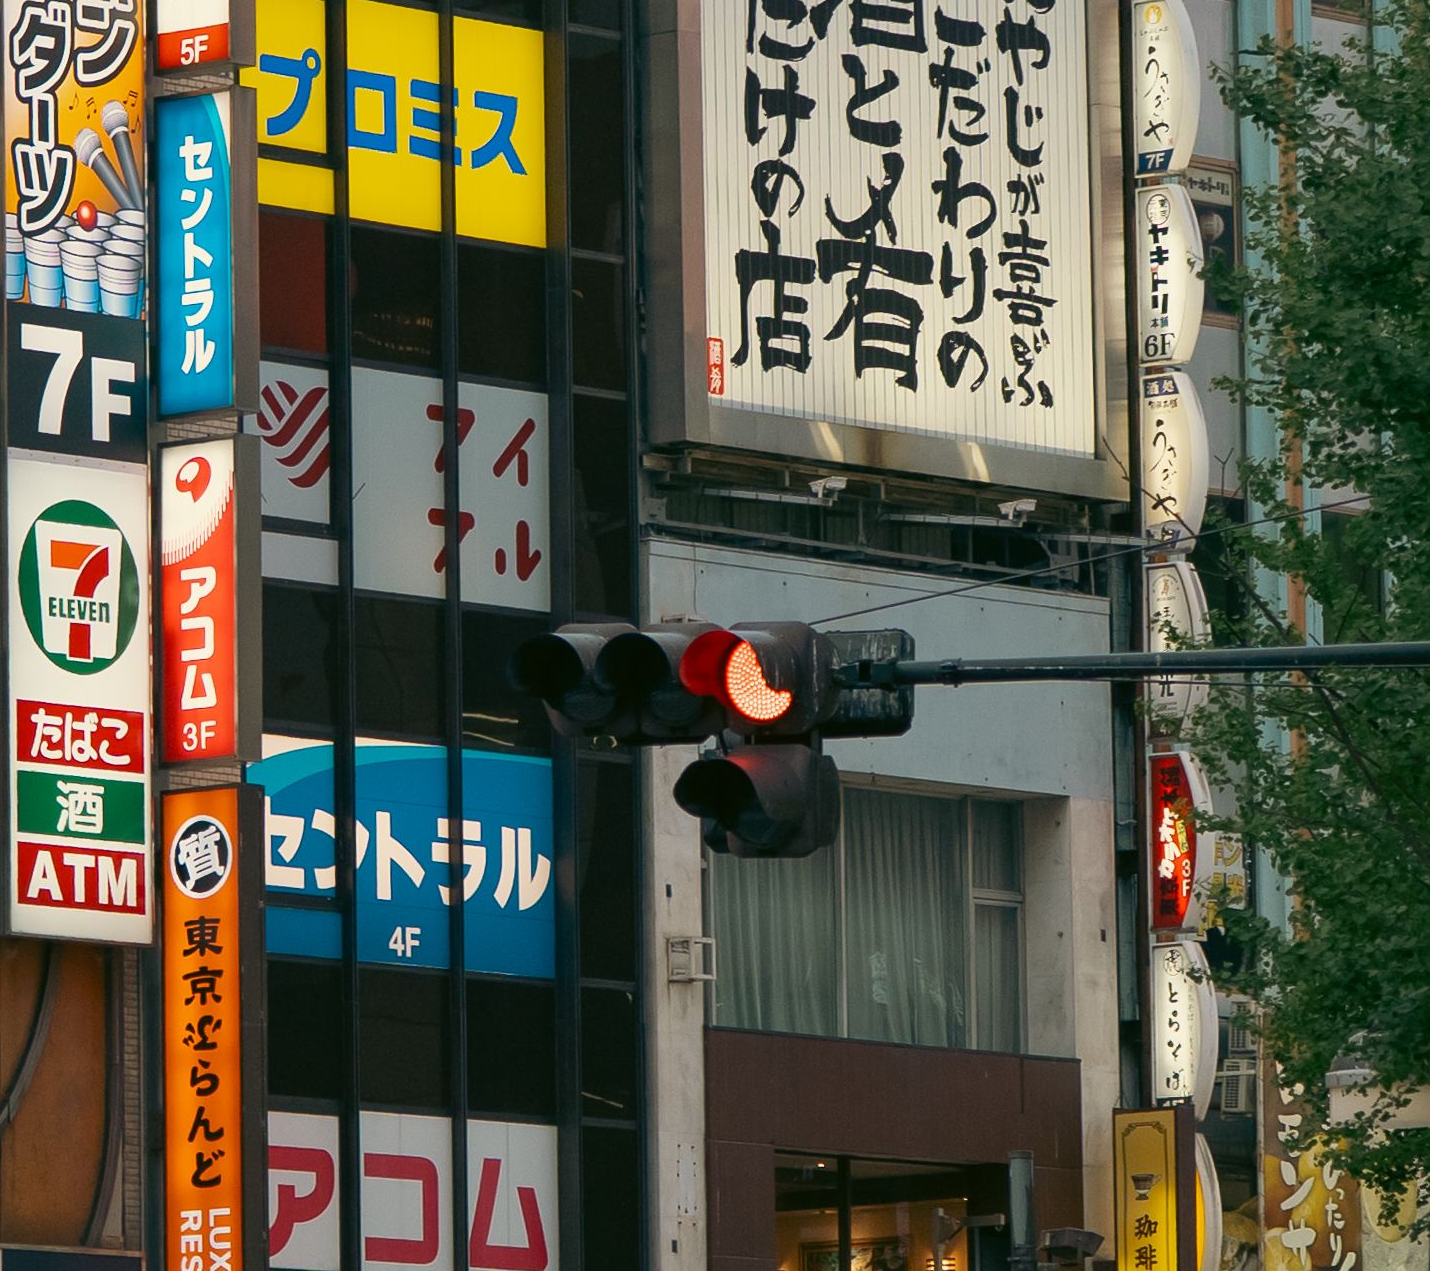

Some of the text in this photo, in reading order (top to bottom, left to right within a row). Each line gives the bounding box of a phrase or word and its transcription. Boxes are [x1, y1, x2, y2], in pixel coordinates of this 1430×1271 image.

[180, 37, 207, 65] 5F
[259, 47, 528, 176] プロミス
[1145, 154, 1165, 168] 7F
[179, 136, 215, 375] セントラル
[1148, 224, 1170, 315] ヤキトリ
[1144, 332, 1176, 358] 6F
[20, 322, 135, 442] 7F
[181, 567, 216, 711] アコム
[29, 708, 130, 767] たばこ
[183, 721, 216, 750] 3F
[56, 781, 103, 834] 酒
[26, 850, 136, 909] ATM
[177, 832, 223, 888] 質
[264, 794, 551, 912] セントラル
[1182, 859, 1191, 897] 3F
[388, 925, 421, 958] 4F
[181, 917, 224, 1188] 東京ぶらんど
